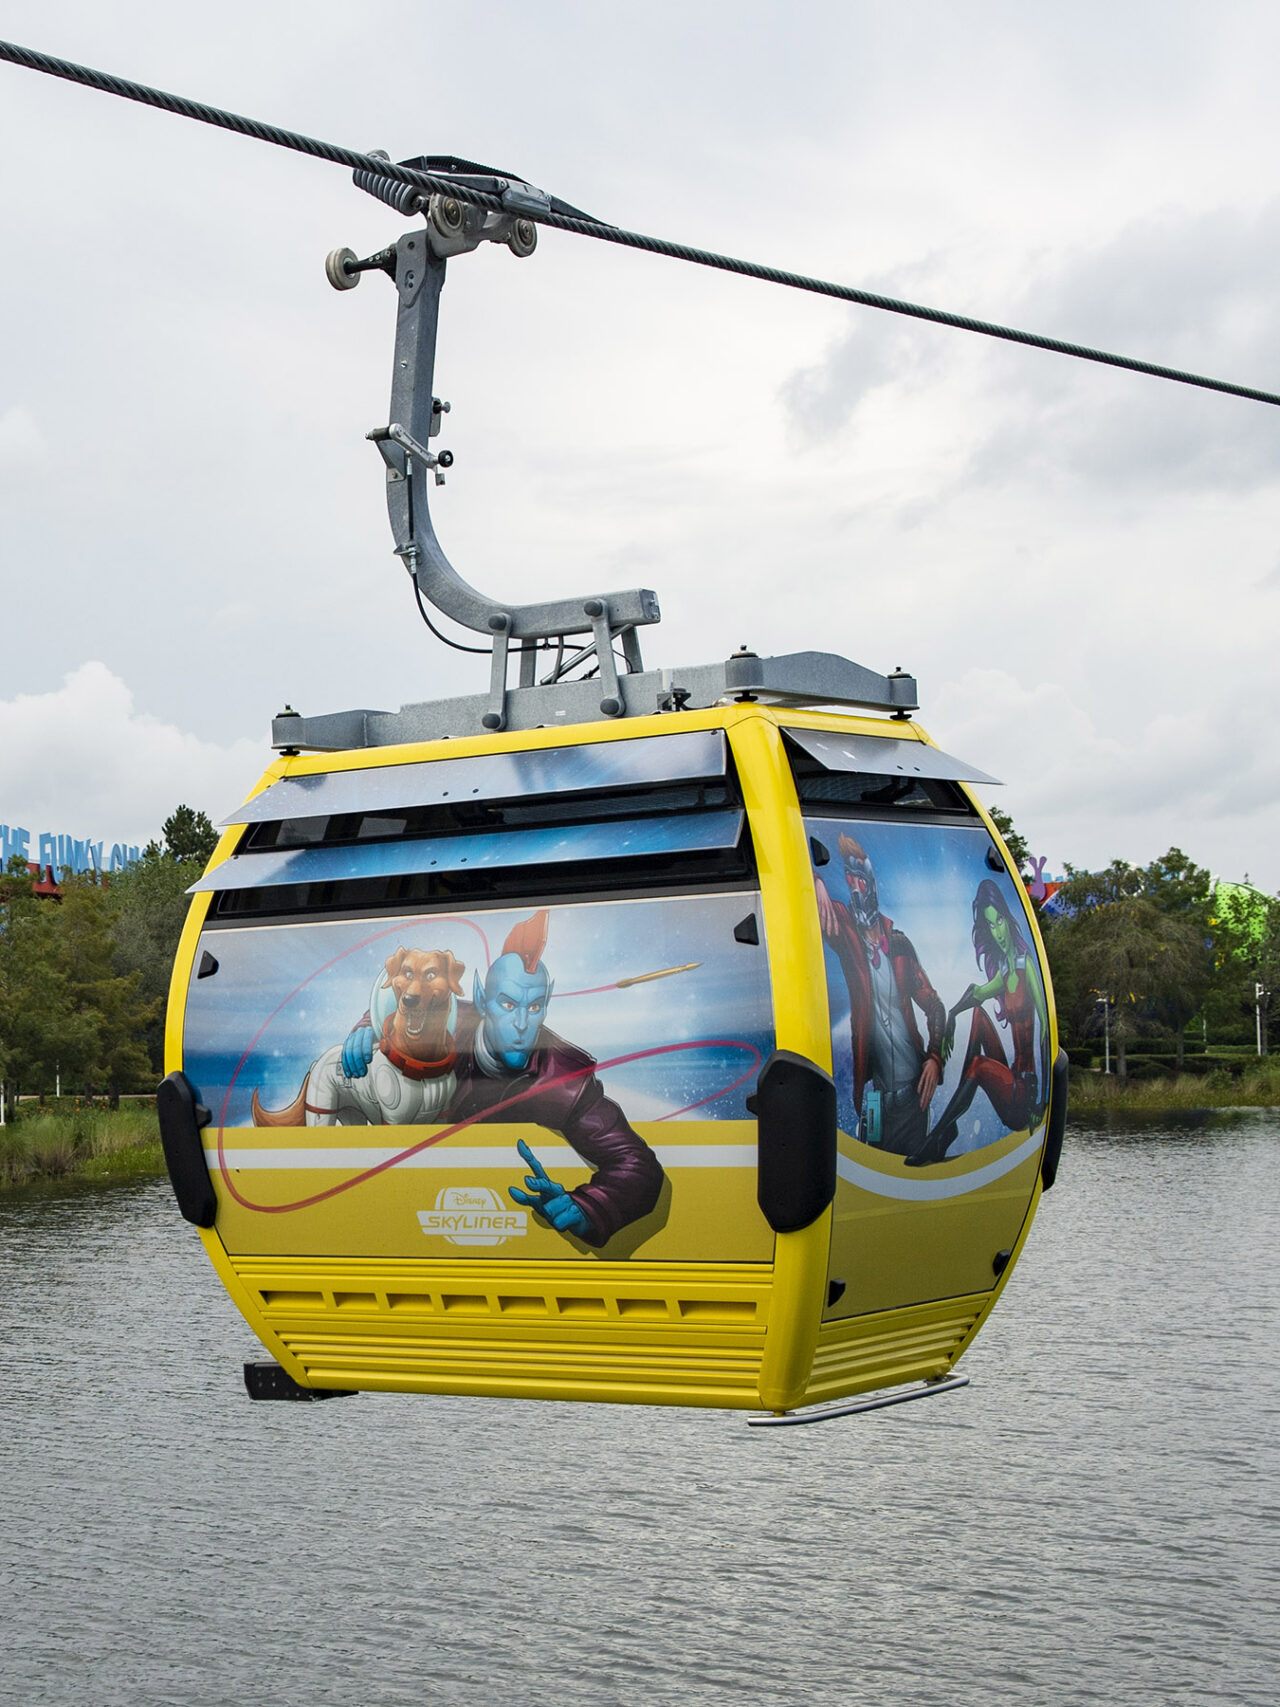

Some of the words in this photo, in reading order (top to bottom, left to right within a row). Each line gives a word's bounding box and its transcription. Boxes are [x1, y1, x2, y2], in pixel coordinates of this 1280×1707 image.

[39, 832, 104, 885] FUNKY
[450, 1191, 487, 1209] Disney
[426, 1213, 519, 1232] SKYLINER
